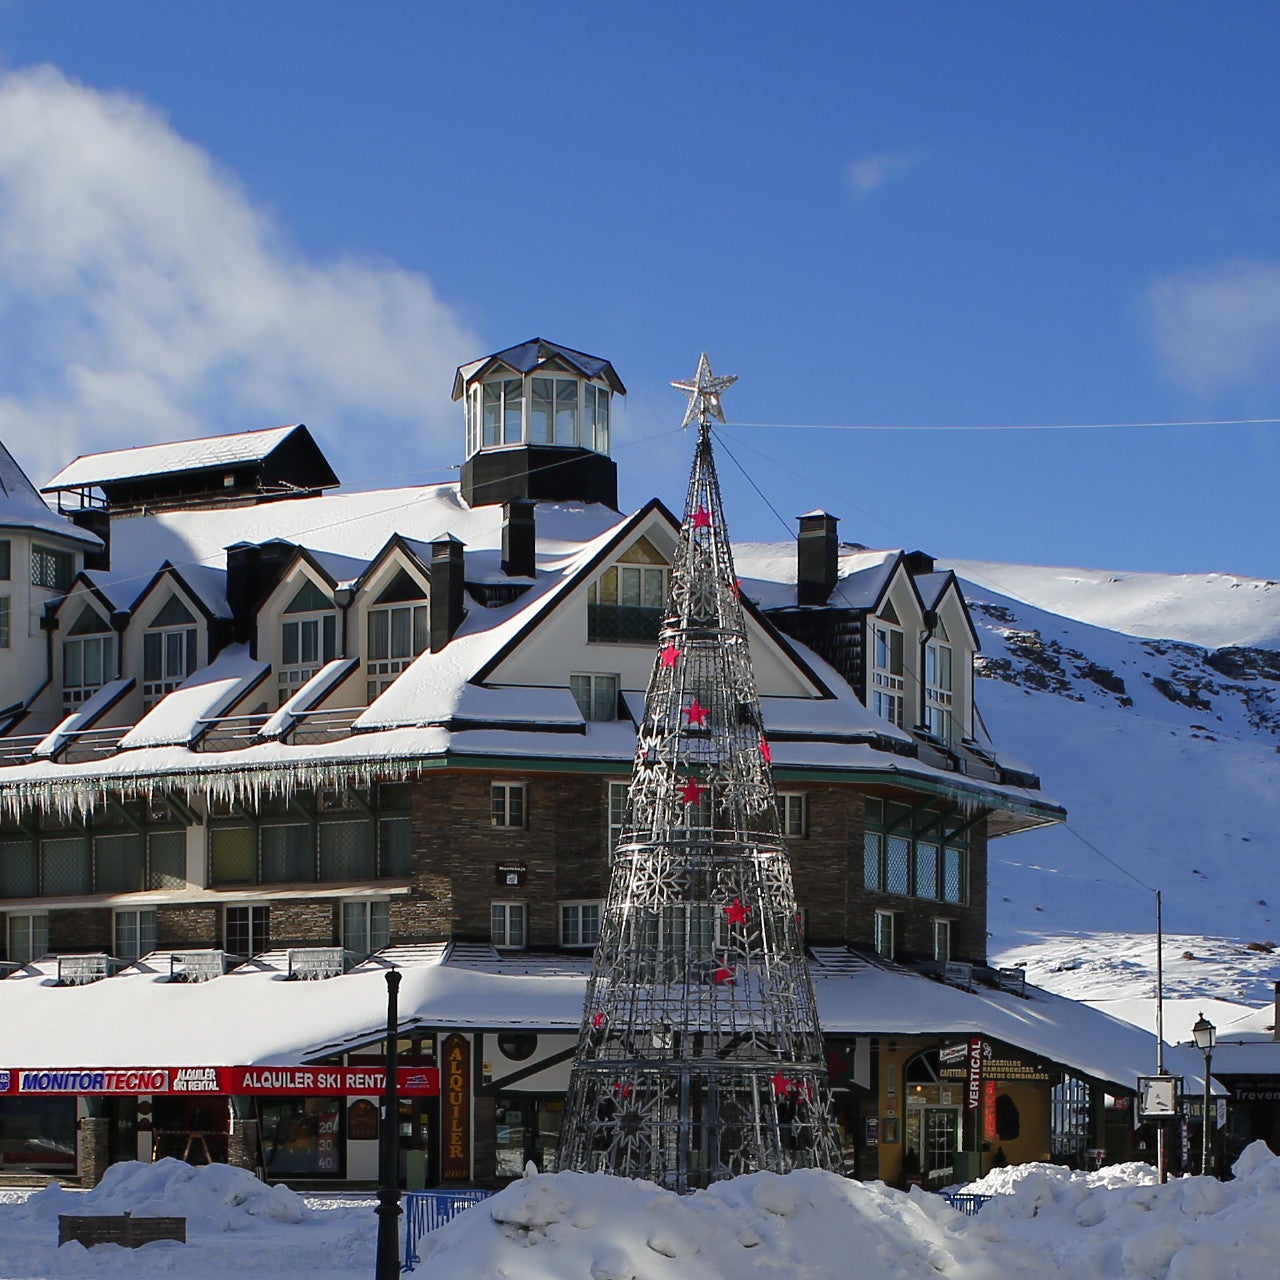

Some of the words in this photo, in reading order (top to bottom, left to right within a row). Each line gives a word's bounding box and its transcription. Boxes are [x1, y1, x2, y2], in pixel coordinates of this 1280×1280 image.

[177, 1069, 216, 1081] ALQUILER
[243, 1072, 314, 1088] ALQUILER
[317, 1074, 341, 1088] SKI
[346, 1074, 401, 1089] RENT
[969, 1040, 981, 1108] VERTICAL
[173, 1080, 187, 1091] SKI
[188, 1080, 220, 1091] RENTAL
[448, 1047, 464, 1158] ALQUILER
